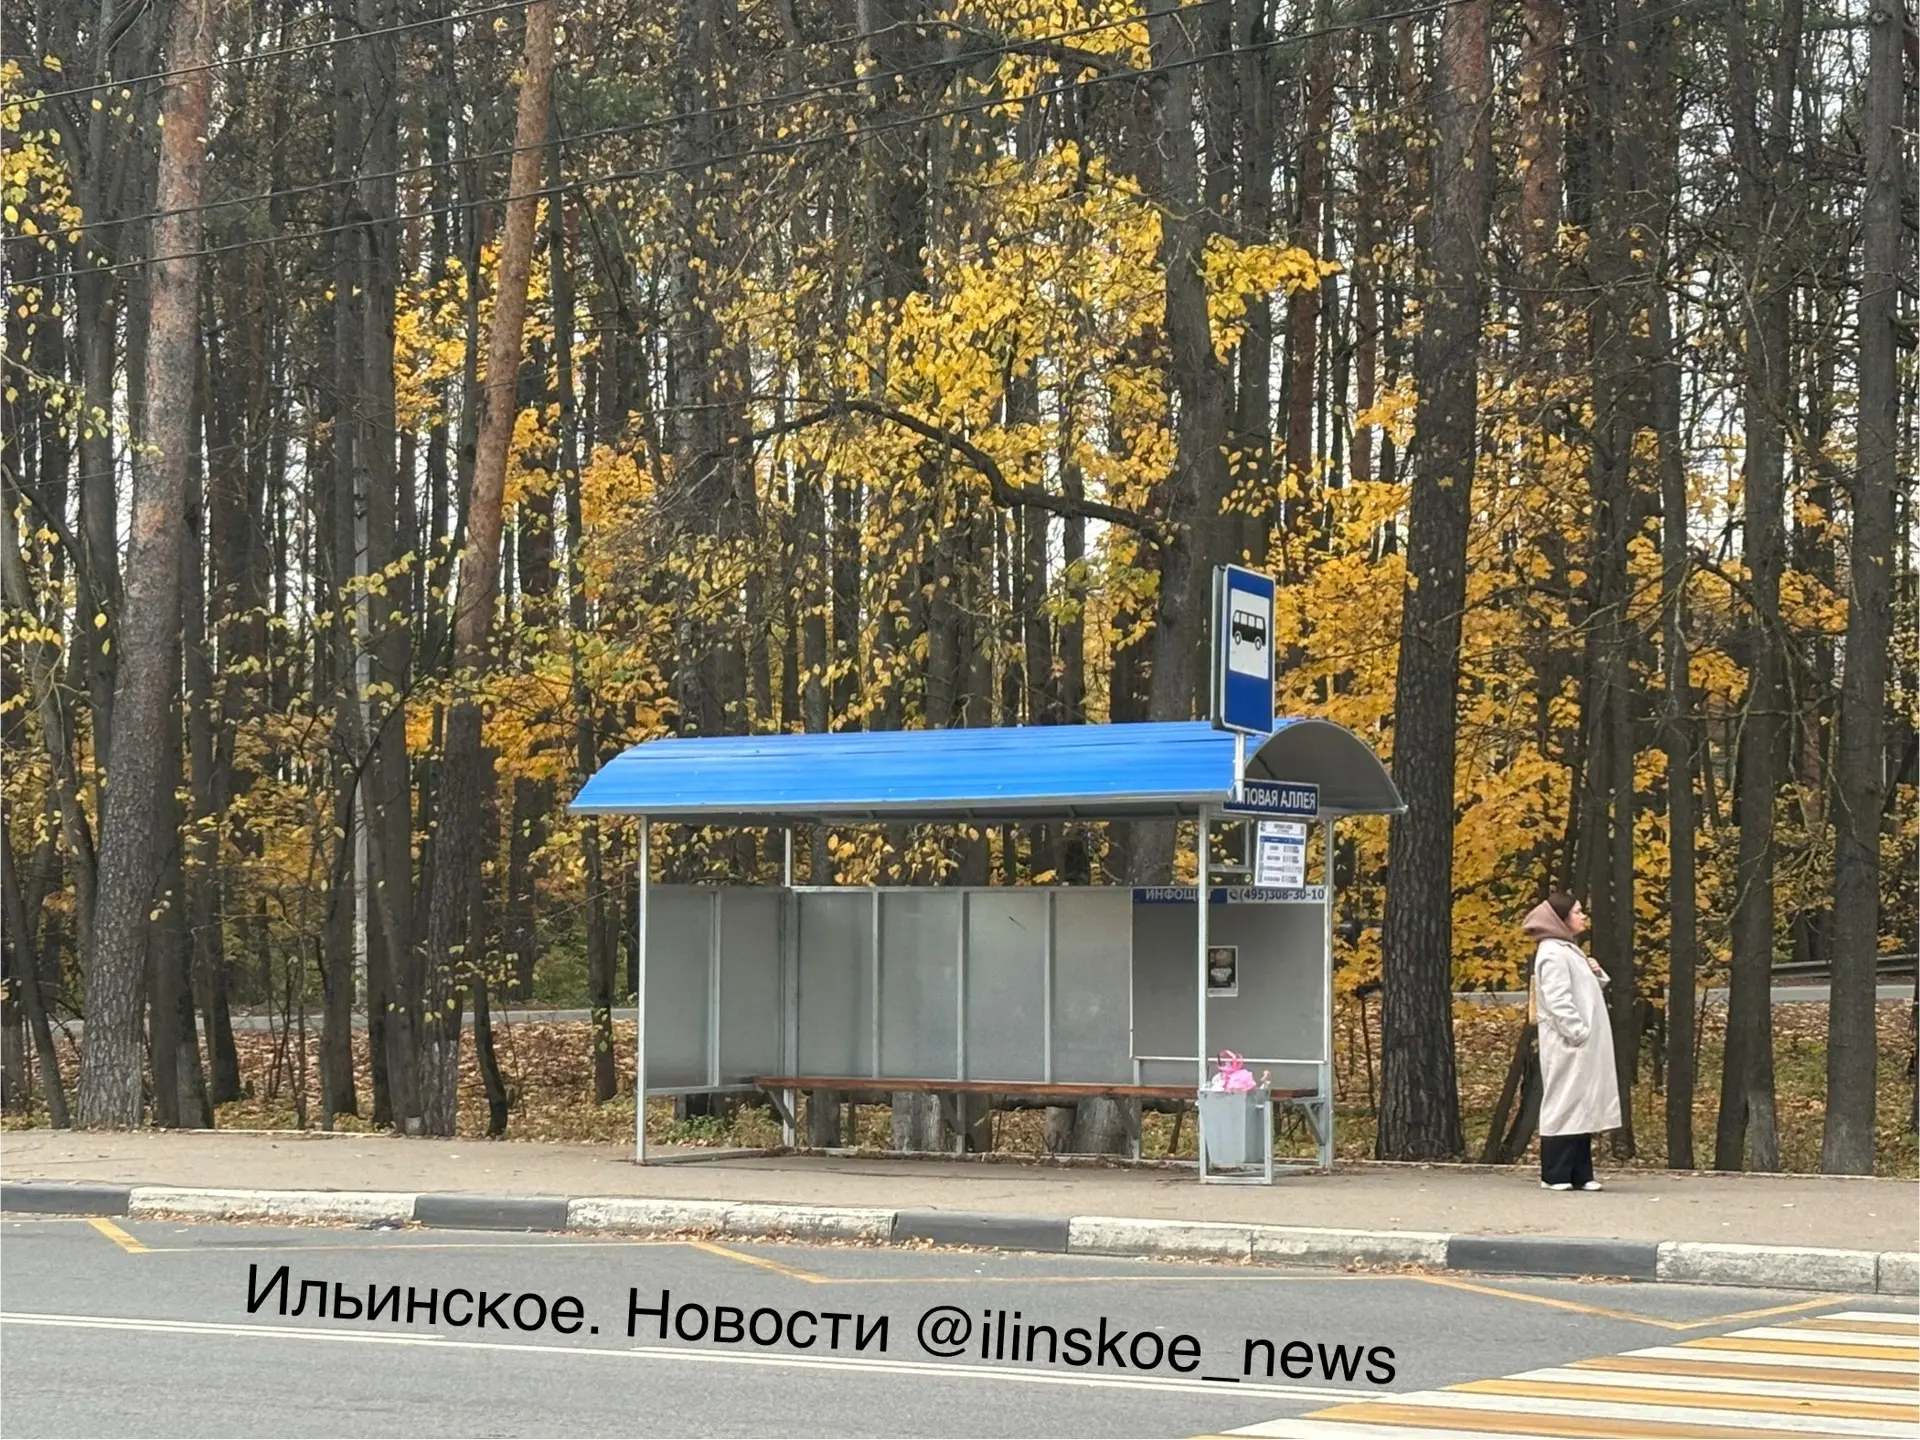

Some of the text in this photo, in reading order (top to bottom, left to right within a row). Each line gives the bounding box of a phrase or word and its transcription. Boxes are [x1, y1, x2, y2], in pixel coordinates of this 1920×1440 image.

[1226, 788, 1317, 810] ПОВАЯ АЛЛЕЯ
[1240, 887, 1325, 902] (495)308-30-10
